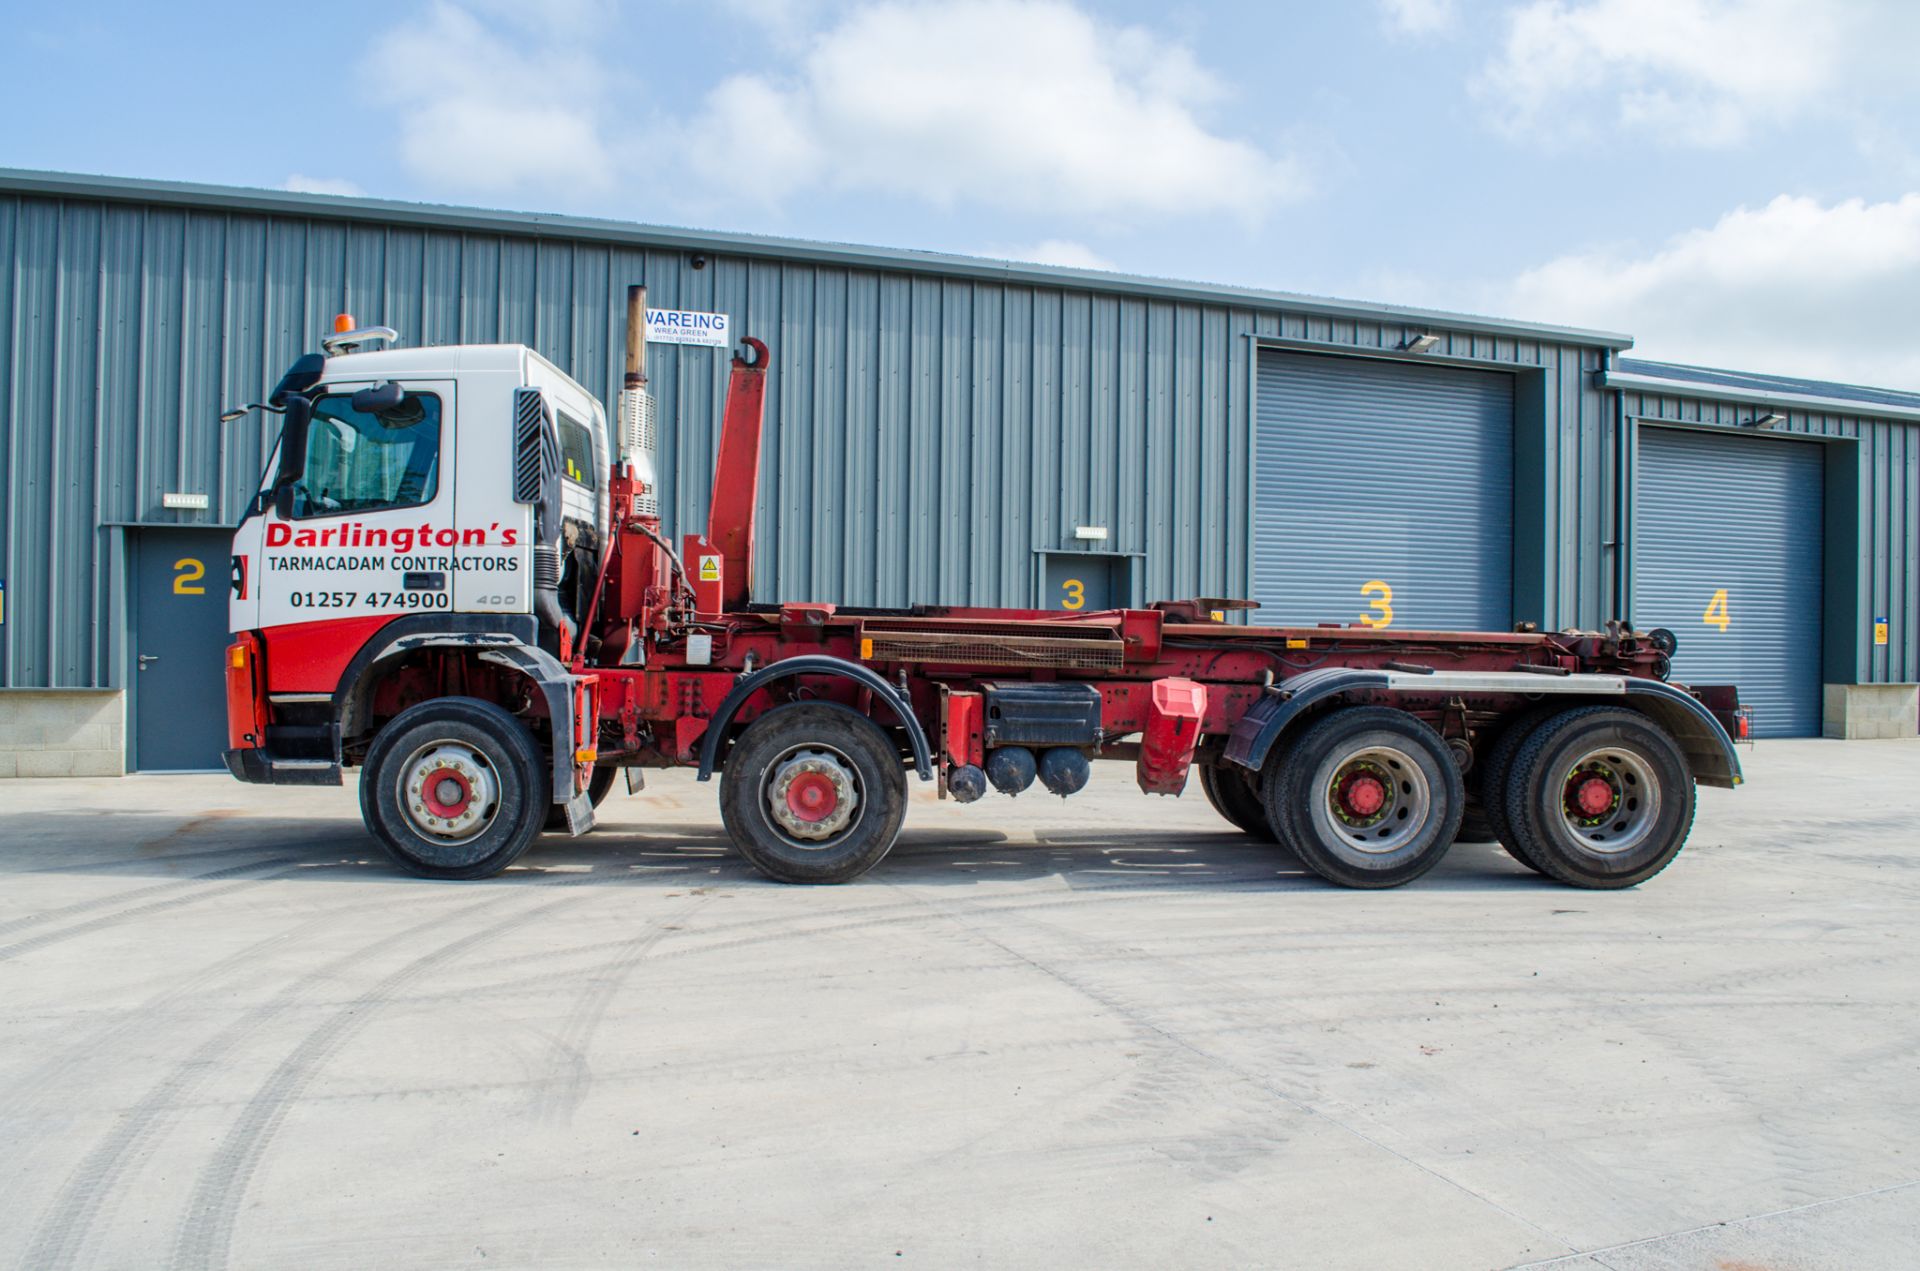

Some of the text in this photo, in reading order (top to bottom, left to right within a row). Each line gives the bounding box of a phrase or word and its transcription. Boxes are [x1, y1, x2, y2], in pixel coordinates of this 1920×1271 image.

[654, 327, 708, 337] WREA GREEN
[266, 522, 517, 553] Darlington's
[173, 558, 205, 594] 2
[268, 556, 518, 571] TARMACADAM CONTRACTORS
[290, 591, 449, 609] 01257 474900
[476, 595, 516, 605] 400
[1061, 579, 1085, 610] 3
[1360, 580, 1393, 629] 3
[1703, 588, 1731, 632] 4
